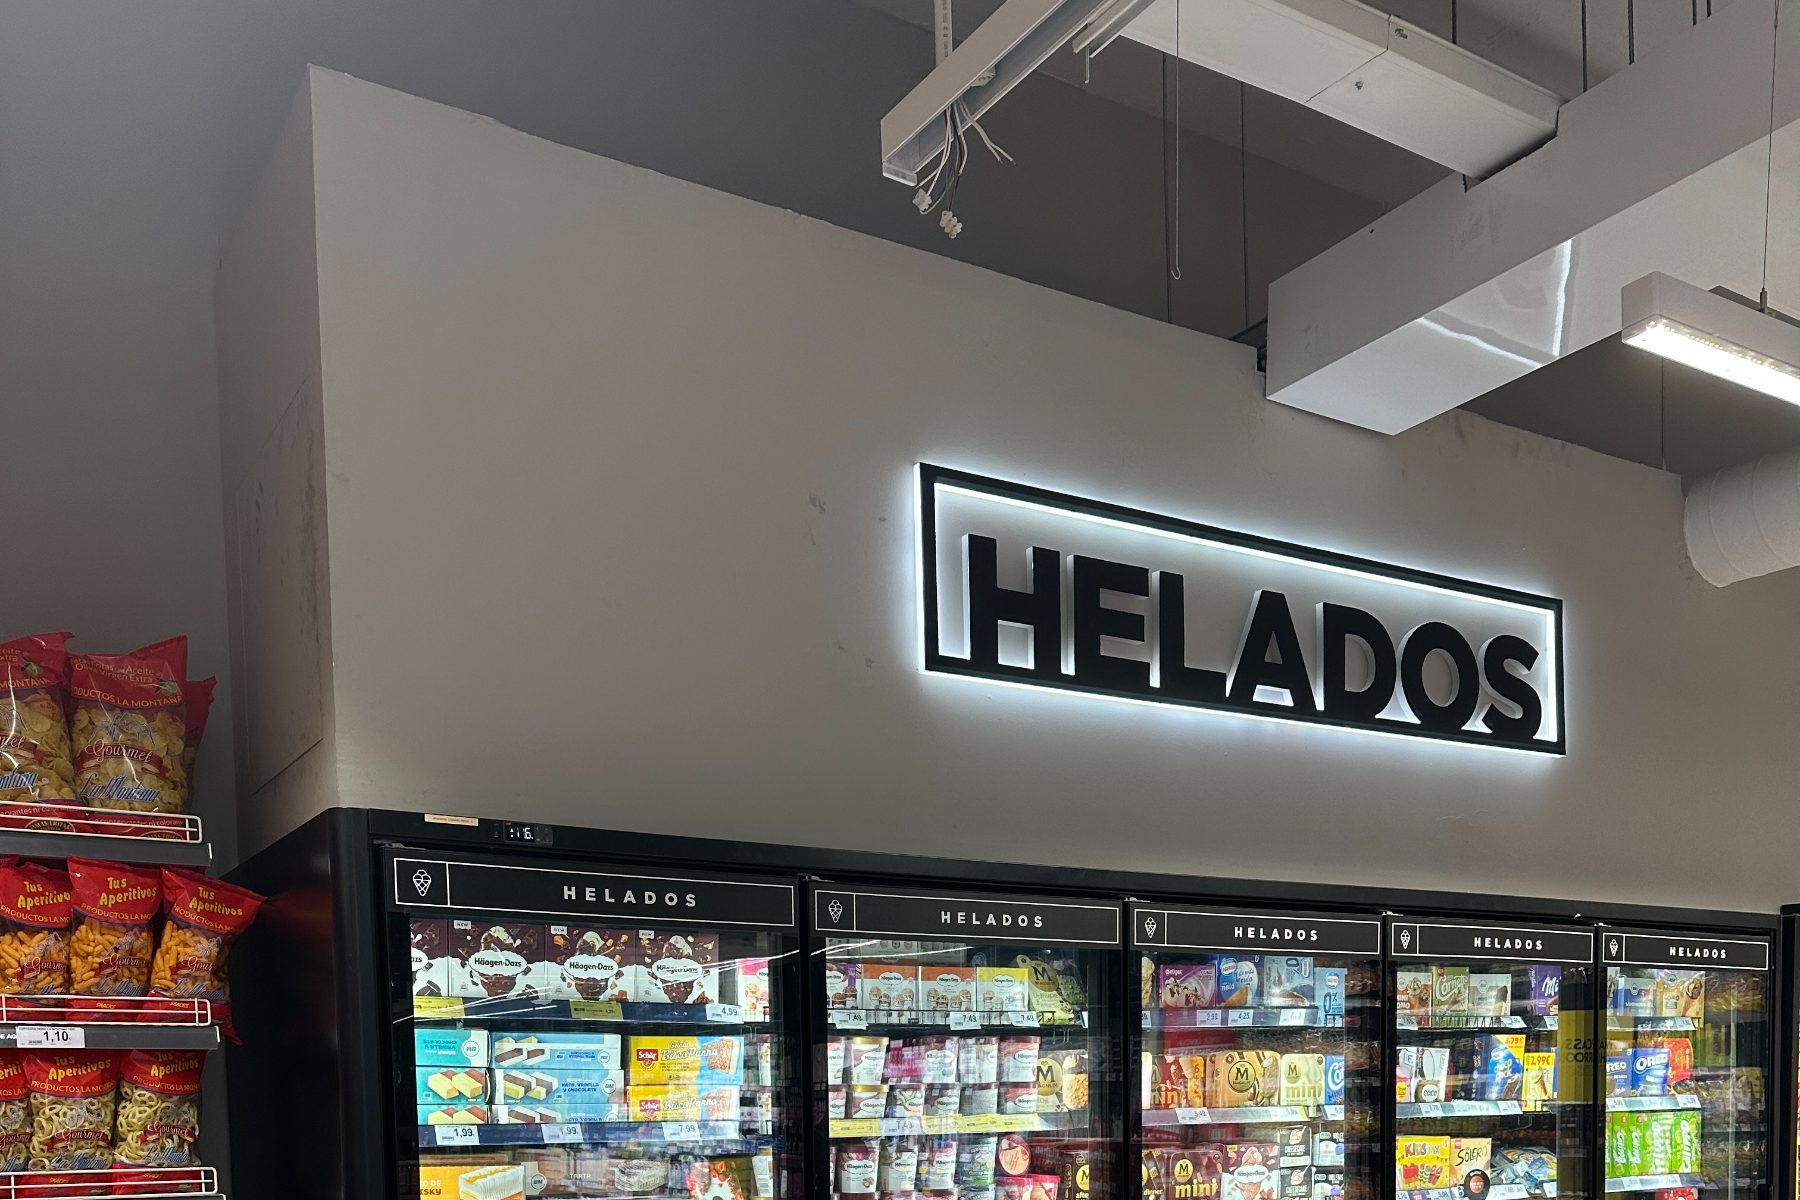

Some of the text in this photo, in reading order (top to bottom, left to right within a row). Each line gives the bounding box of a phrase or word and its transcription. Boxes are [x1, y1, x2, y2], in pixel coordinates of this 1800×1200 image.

[963, 533, 1543, 741] HELADOS
[85, 738, 153, 762] Gourmet
[23, 881, 43, 893] Tus
[107, 876, 127, 889] Tus
[17, 890, 71, 910] Aperitivo
[99, 885, 157, 908] Aperitivos
[199, 886, 215, 901] Tus
[564, 885, 697, 908] HELADOS
[0, 904, 48, 922] PRODUCTOS
[81, 902, 129, 920] PRODUCTOS
[188, 896, 243, 916] Aperitivos
[941, 911, 1043, 928] HELADOS
[1234, 926, 1318, 941] HELADOS
[1474, 936, 1543, 950] HELADOS
[1669, 946, 1727, 959] HELADOS
[474, 956, 522, 969] Häagen-Dazs
[569, 960, 614, 972] Häagen-Dazs
[43, 1030, 69, 1043] 1,10
[55, 1055, 75, 1065] Tus
[1606, 1061, 1627, 1073] REO
[1635, 1053, 1667, 1073] OREO
[48, 1058, 111, 1081] Aperitivos
[150, 1057, 199, 1079] Aperitivos
[1036, 1065, 1055, 1082] M
[1235, 1068, 1249, 1081] M
[1288, 1064, 1298, 1075] M
[31, 1080, 80, 1093] PRODUCTOS
[133, 1075, 175, 1091] PRODUCTOS
[1286, 1083, 1323, 1098] mini
[1423, 1089, 1437, 1097] COCO
[454, 1128, 473, 1137] 1,99
[1405, 1143, 1427, 1157] KIDS
[1178, 1163, 1189, 1175] M
[1175, 1179, 1217, 1198] mini
